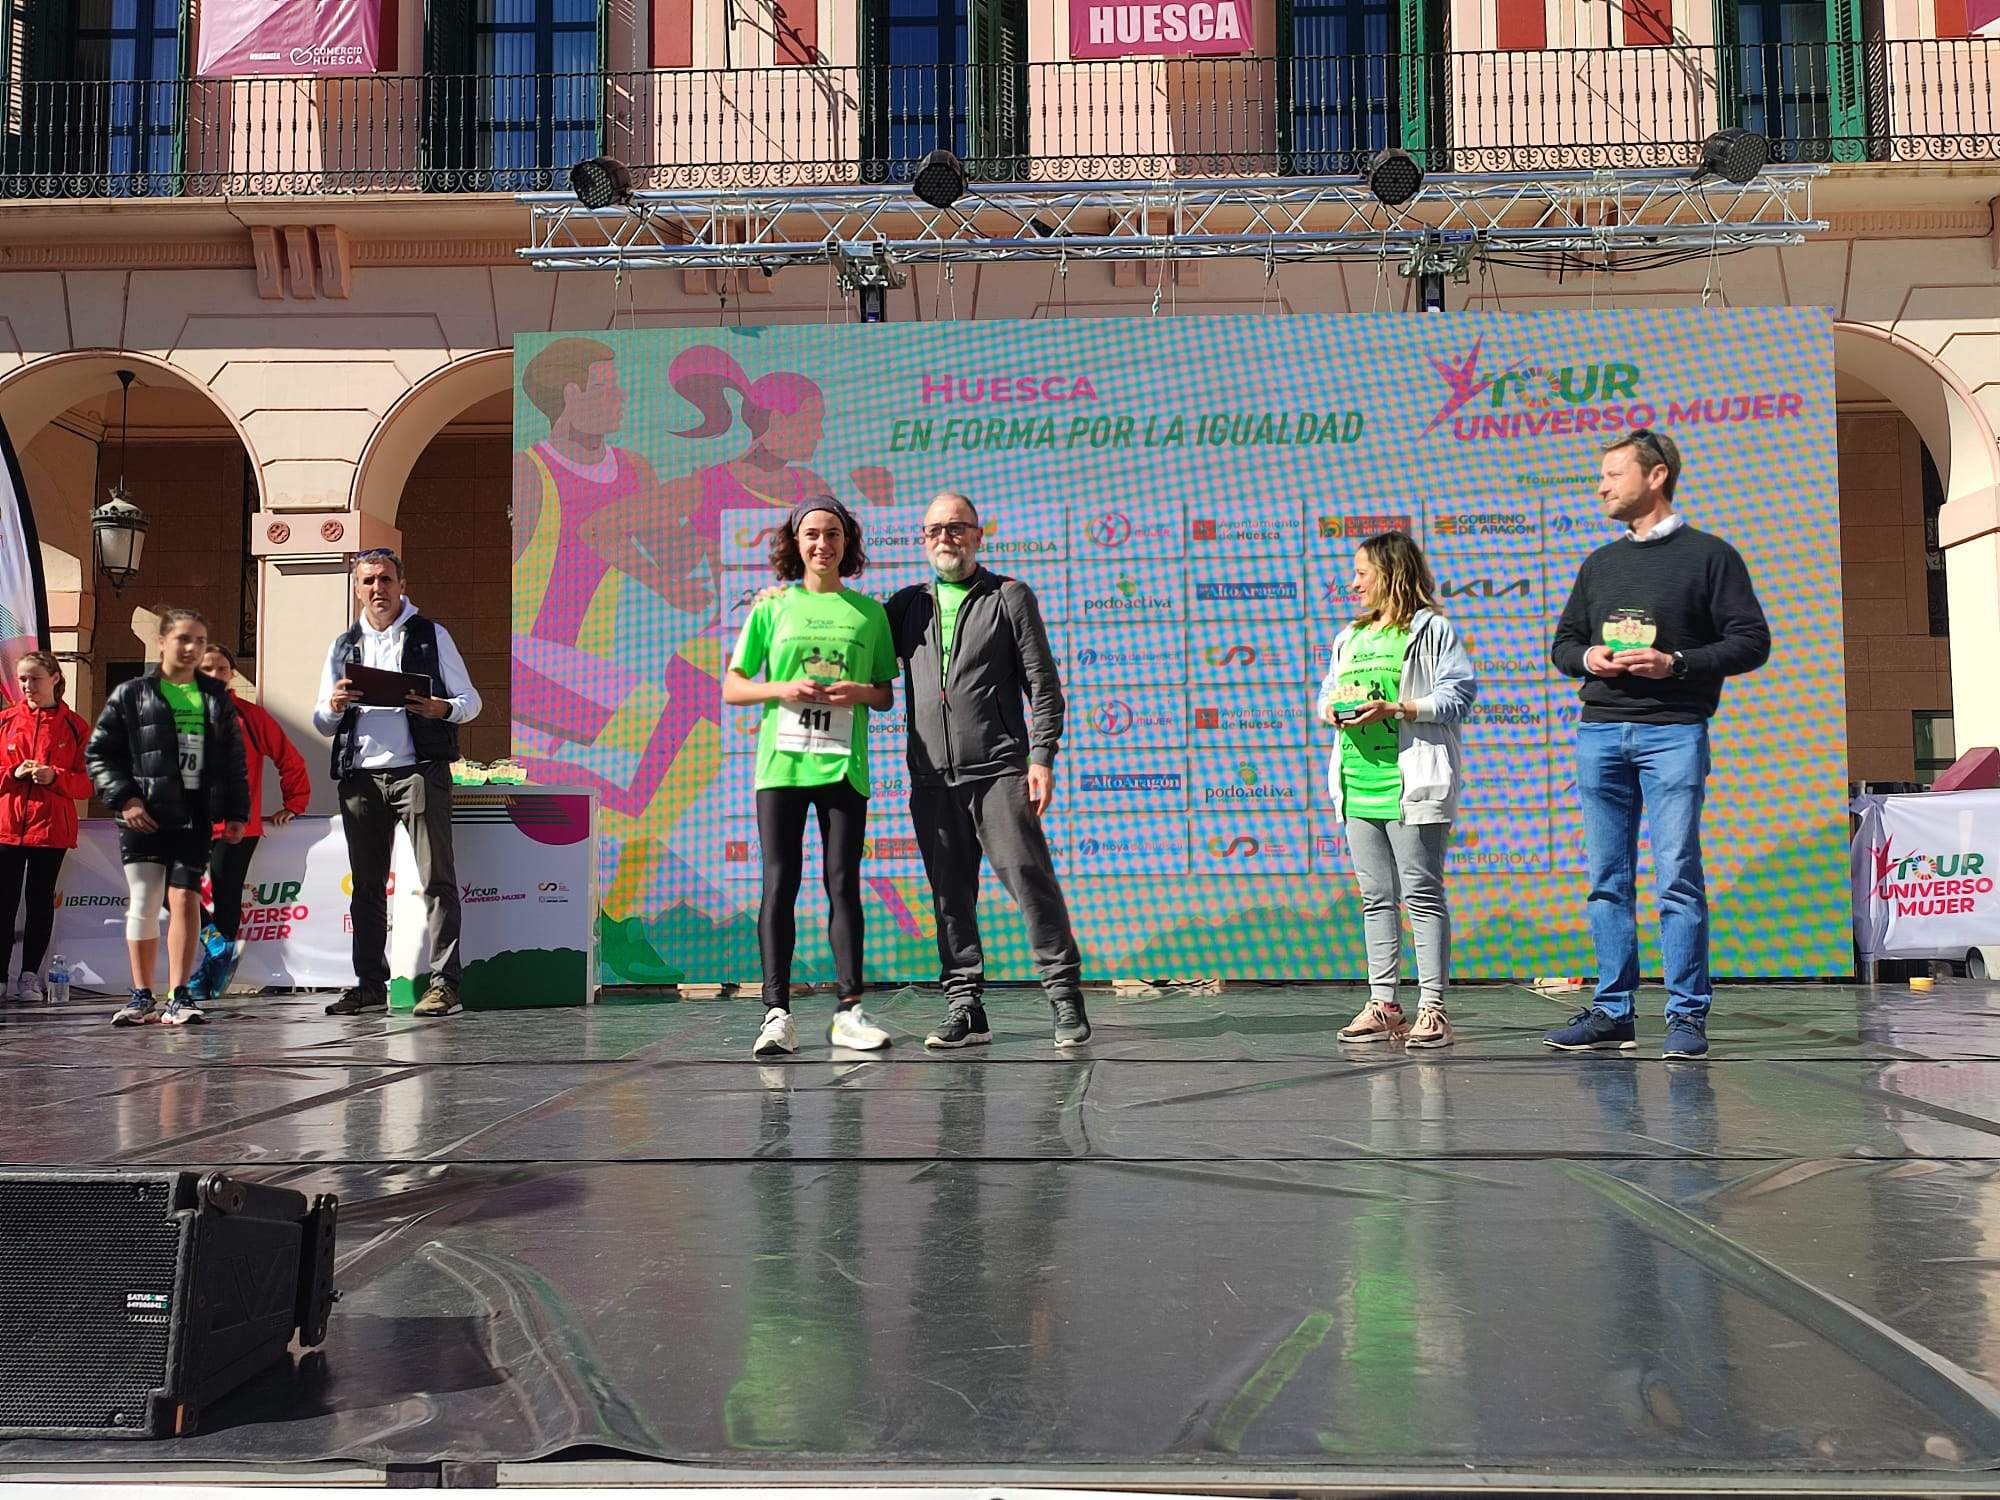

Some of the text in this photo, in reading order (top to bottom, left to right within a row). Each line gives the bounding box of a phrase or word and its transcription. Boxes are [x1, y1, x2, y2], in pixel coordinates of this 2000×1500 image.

[1089, 2, 1241, 44] HUESCA
[314, 46, 363, 56] COMERCIO
[313, 56, 363, 65] HUESCA
[920, 374, 1098, 403] HUESCA
[1485, 363, 1640, 408] TOUR
[1453, 393, 1804, 441] UNIVERSO MUJER
[889, 410, 1365, 453] EN FORMA POR LA IGUALDAD
[1219, 517, 1300, 530] Ayuntamiento
[1458, 514, 1526, 525] GOBIERNO
[1218, 530, 1281, 540] de Huesca
[1458, 525, 1476, 535] DE
[867, 536, 909, 546] DEPORTE
[976, 541, 1057, 553] BERDROLA
[1206, 583, 1297, 599] AltoAragón
[1084, 597, 1171, 614] podoactiva
[1475, 660, 1536, 673] RDROLA
[1221, 709, 1302, 720] Ayuntamiento
[1472, 704, 1530, 714] OBIERNO
[799, 707, 832, 732] 411
[1135, 716, 1172, 726] MUJER
[1222, 719, 1283, 729] de Huesca
[869, 724, 906, 734] DEPORT
[872, 779, 904, 790] OUR
[1092, 775, 1180, 790] AltoAragón
[1206, 785, 1293, 802] podoactiva
[1452, 852, 1541, 864] IBERDROLA
[1893, 852, 1984, 881] TOUR
[254, 881, 302, 905] UR
[1878, 877, 1994, 901] UNIVERSO
[64, 895, 130, 907] IBERDRO
[1898, 897, 1976, 917] MUJER
[241, 905, 308, 925] VERSO
[236, 924, 291, 942] UJER
